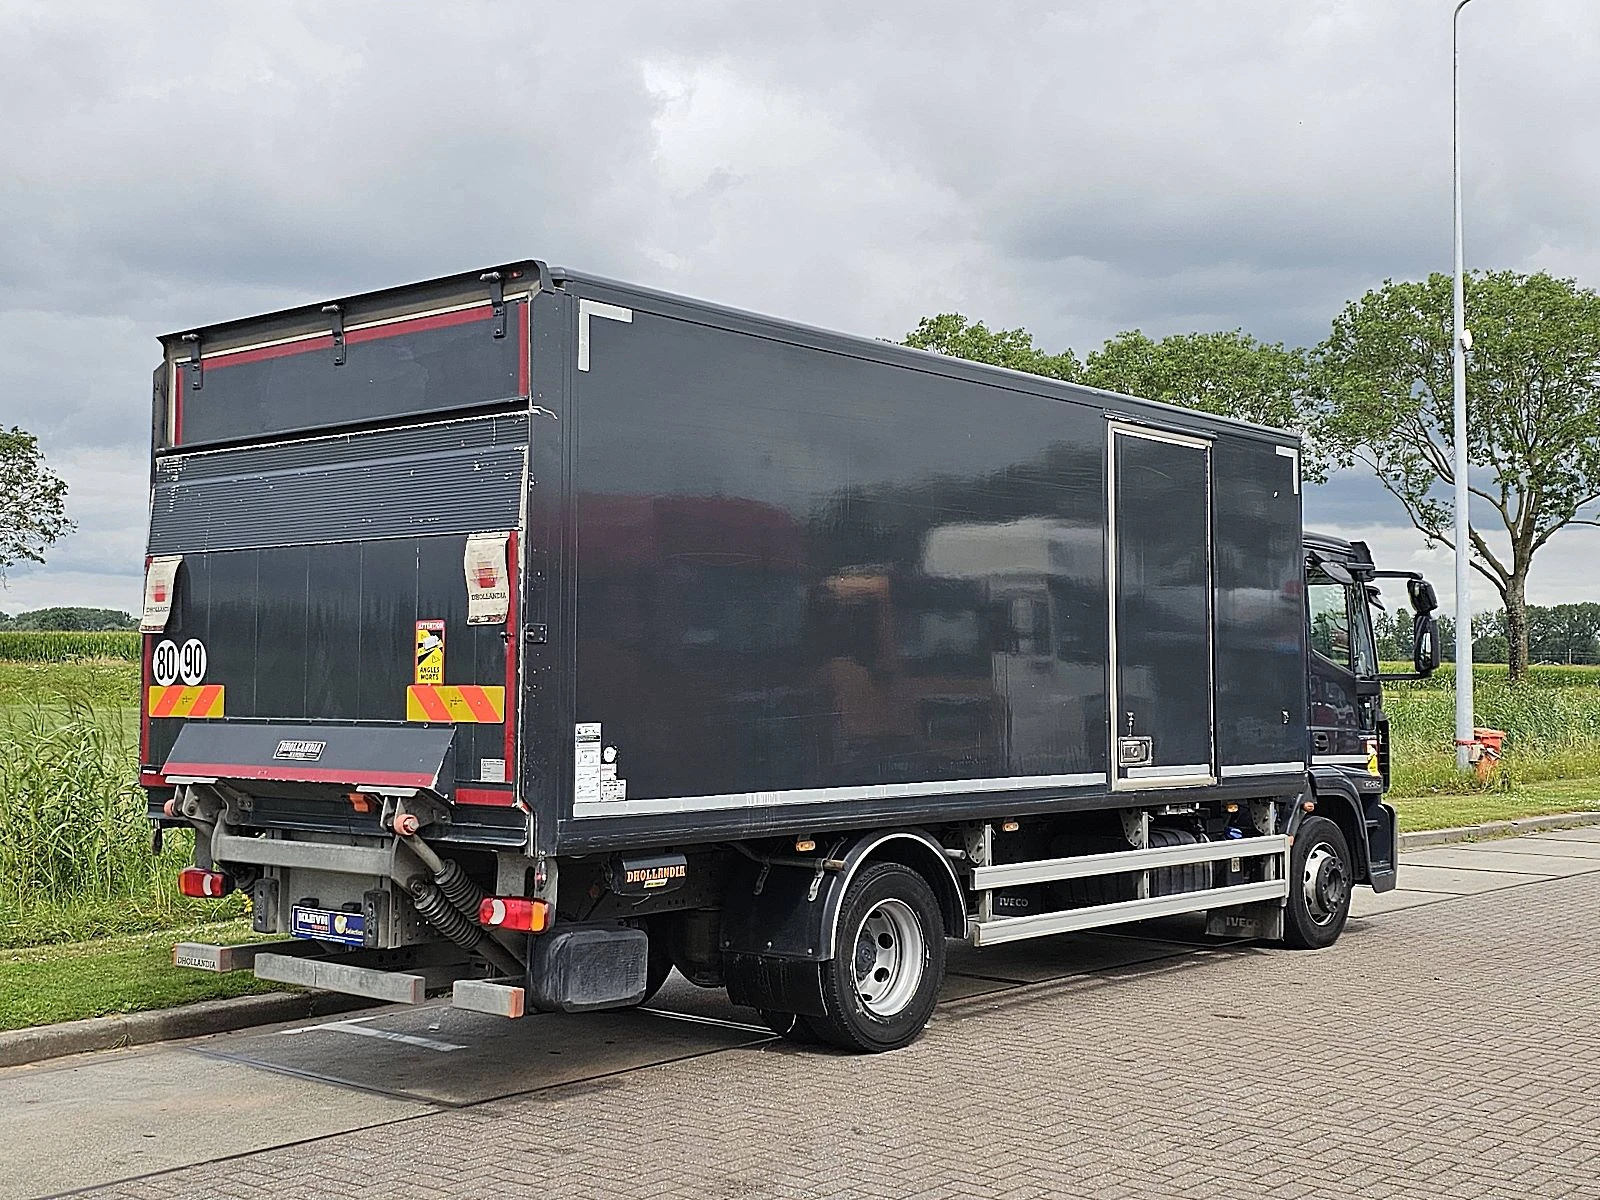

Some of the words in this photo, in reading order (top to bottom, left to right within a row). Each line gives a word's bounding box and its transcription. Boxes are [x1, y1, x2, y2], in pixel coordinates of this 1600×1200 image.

[157, 645, 175, 681] 80
[184, 643, 203, 679] 90
[420, 673, 439, 681] MORTS
[626, 865, 686, 883] DHOLLANDIA
[999, 897, 1029, 907] IVECO
[177, 956, 216, 969] DHOLLANDIA
